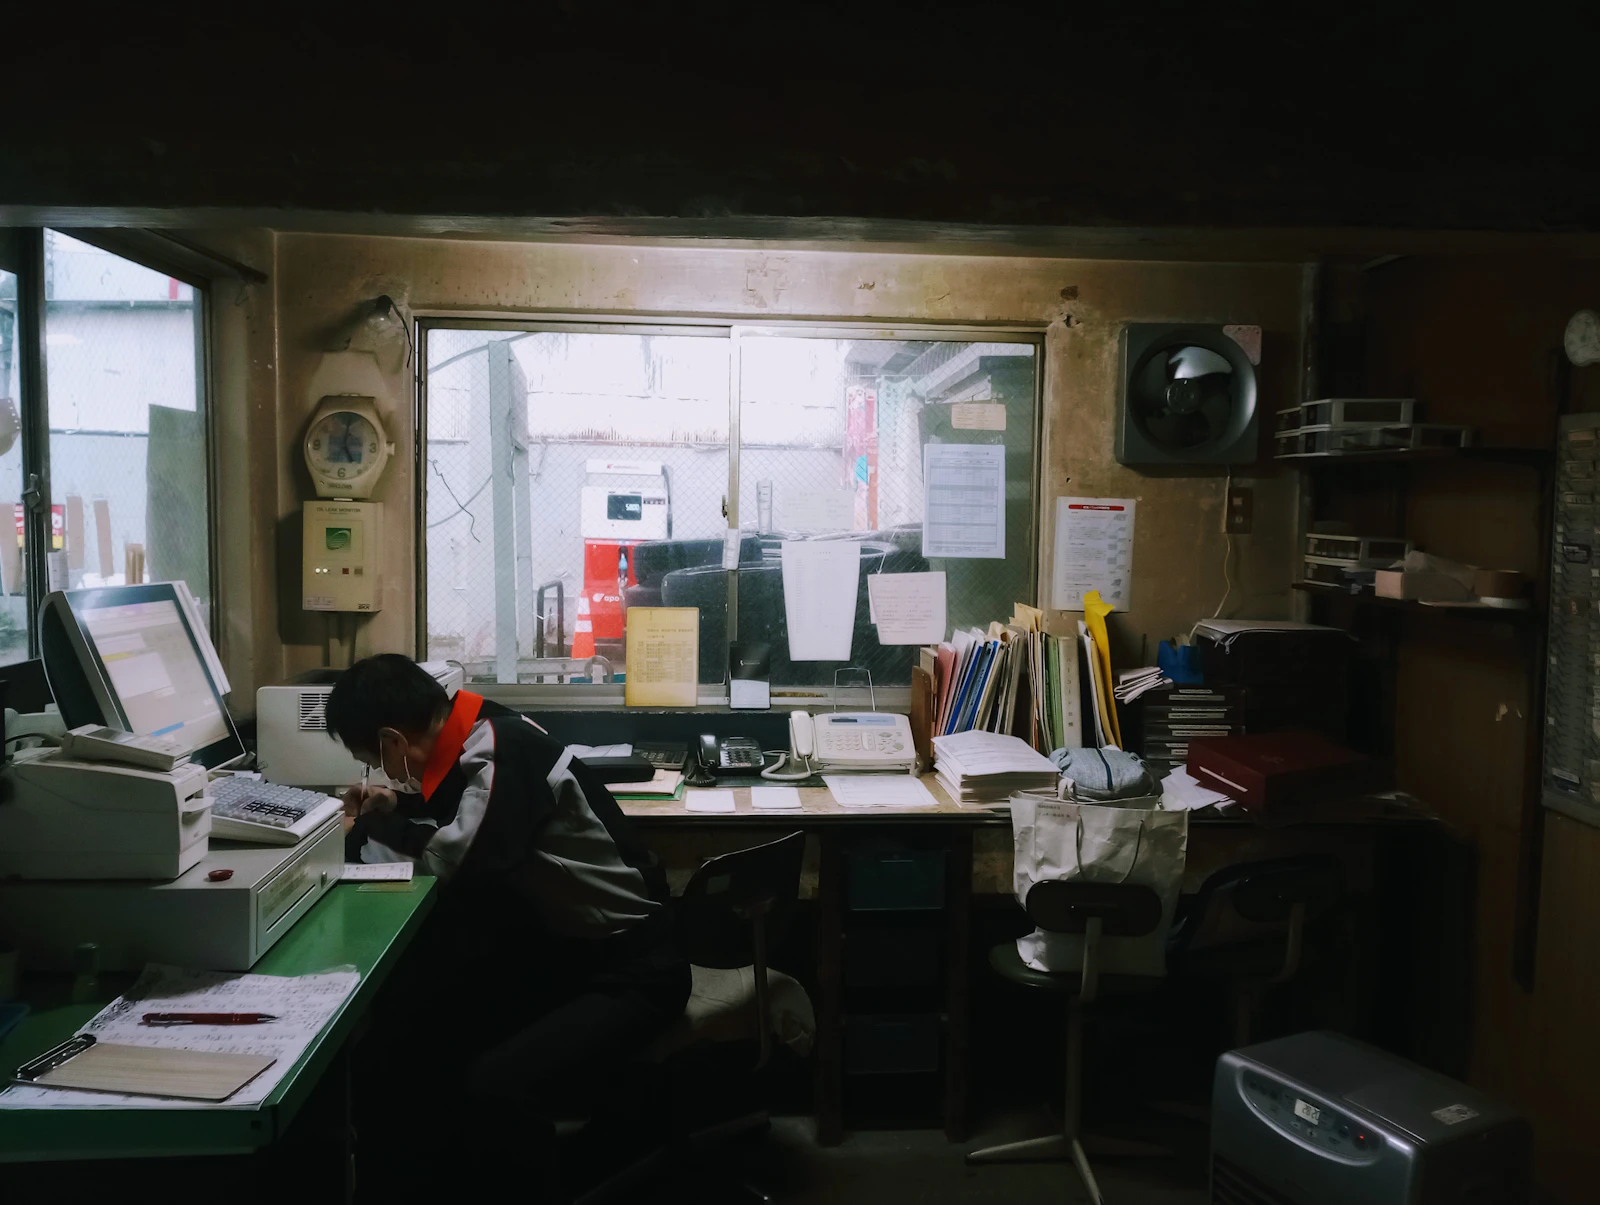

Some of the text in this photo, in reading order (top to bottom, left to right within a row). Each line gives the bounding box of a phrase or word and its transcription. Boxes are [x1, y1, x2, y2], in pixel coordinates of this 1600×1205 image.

[312, 440, 321, 450] 9
[369, 443, 377, 453] 3
[337, 468, 346, 478] 6
